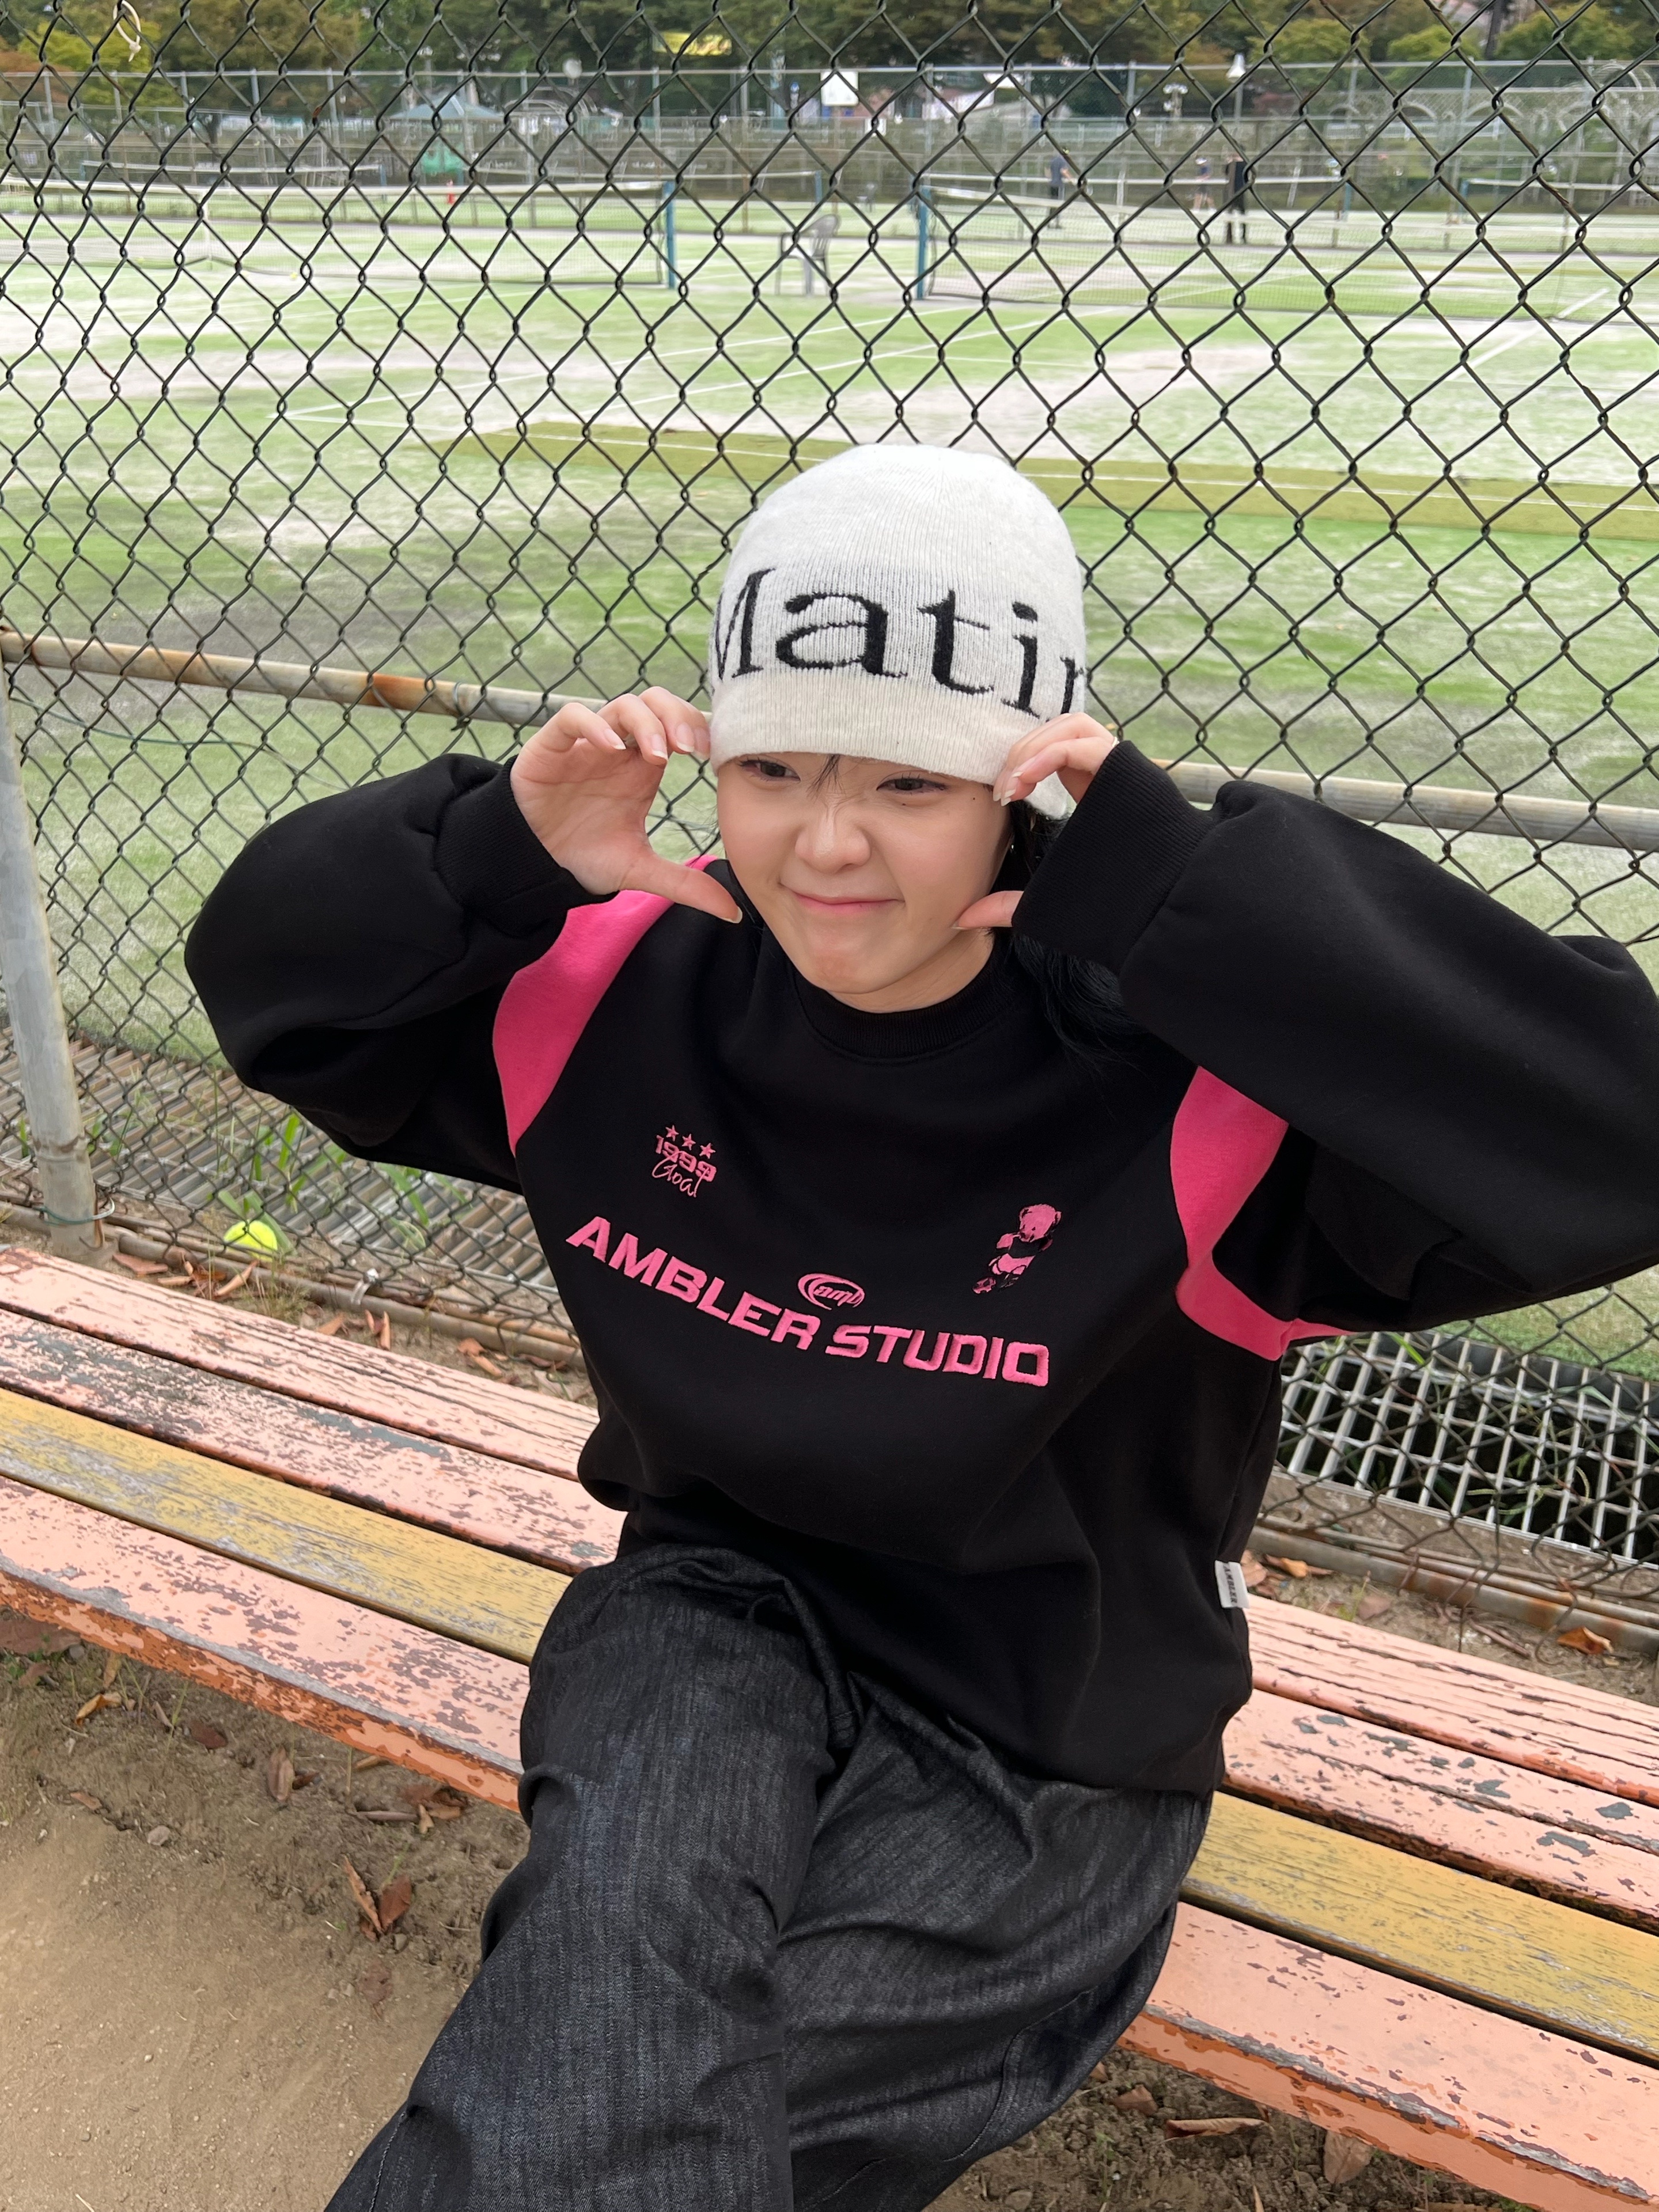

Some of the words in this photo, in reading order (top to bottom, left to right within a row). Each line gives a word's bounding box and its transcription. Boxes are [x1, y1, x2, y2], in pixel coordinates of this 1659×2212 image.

[652, 1150, 709, 1198] Goal
[655, 1134, 717, 1182] 1999
[566, 1216, 821, 1350] AMBLER
[825, 1325, 1050, 1387] STUDIO
[1223, 1565, 1238, 1603] AMBLER
